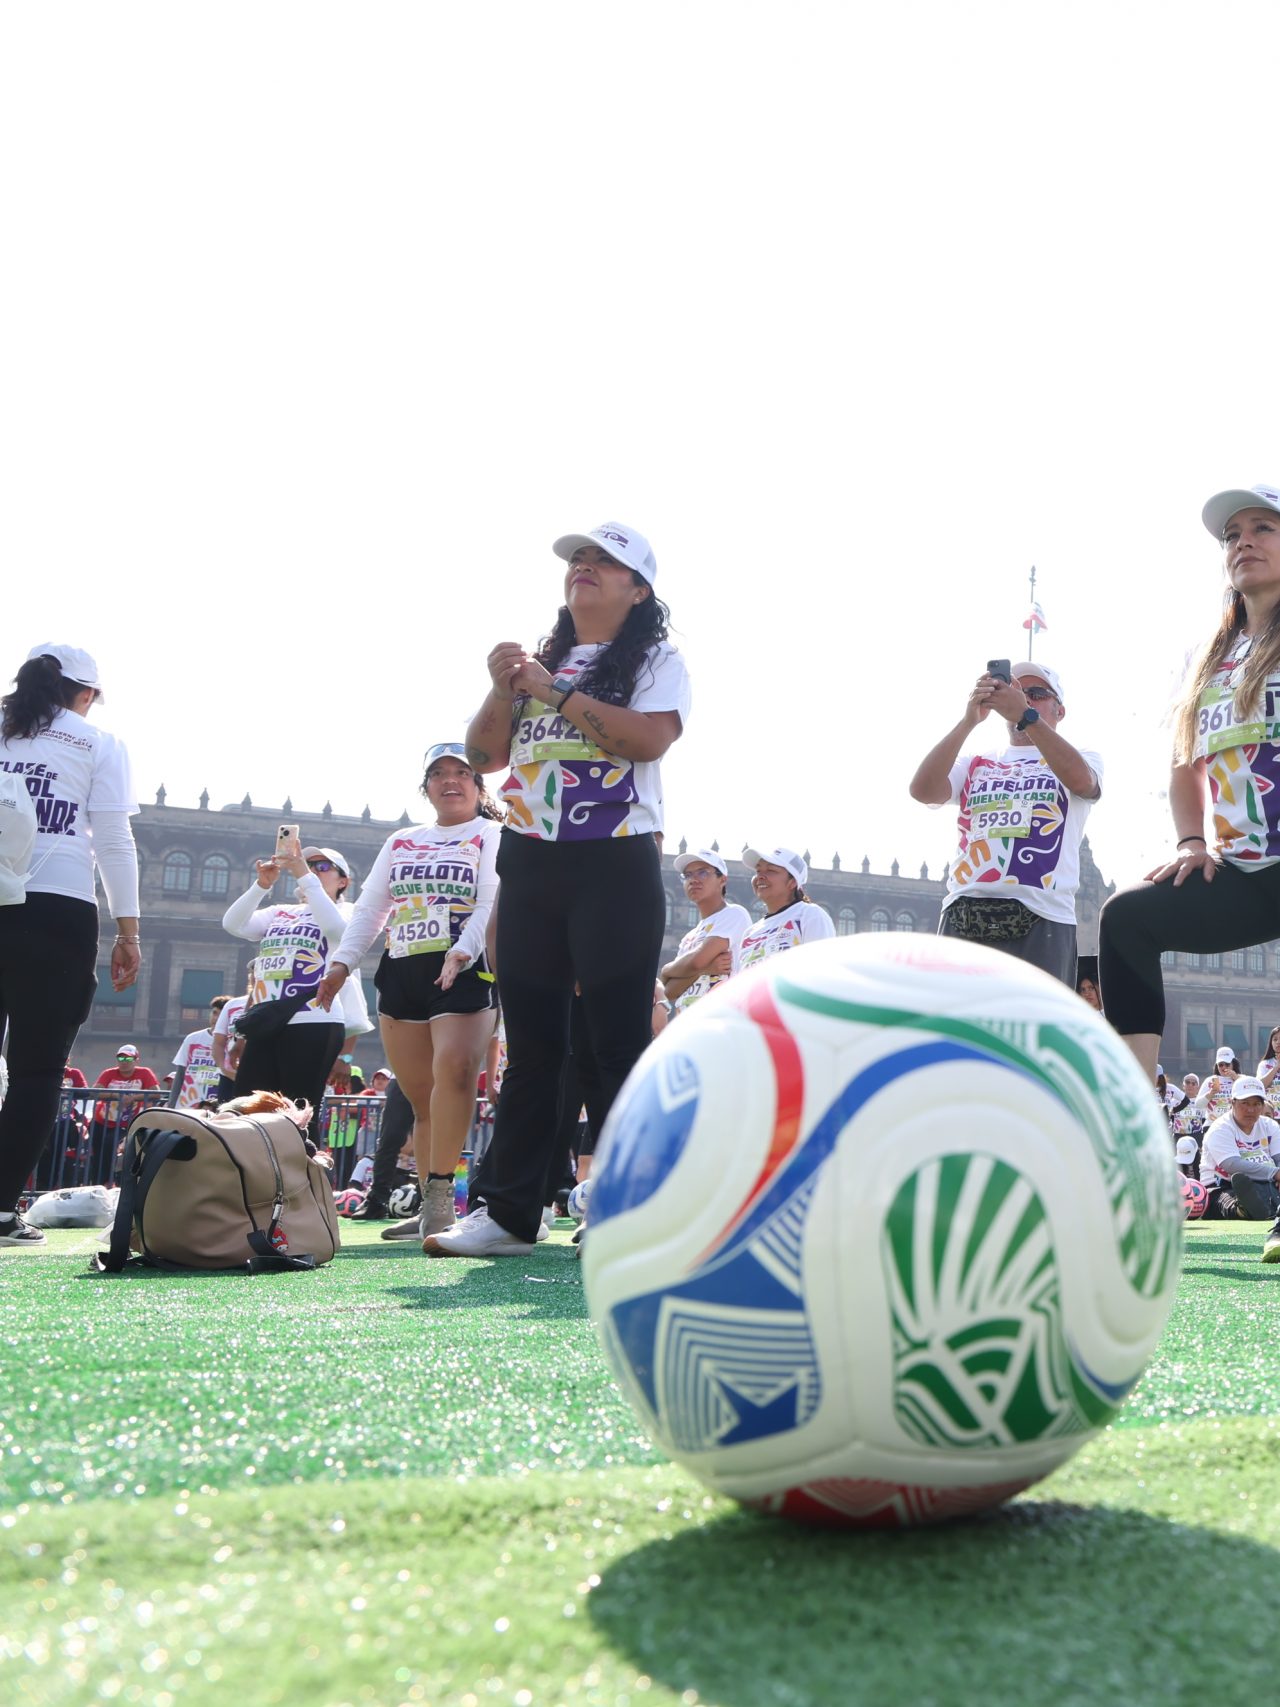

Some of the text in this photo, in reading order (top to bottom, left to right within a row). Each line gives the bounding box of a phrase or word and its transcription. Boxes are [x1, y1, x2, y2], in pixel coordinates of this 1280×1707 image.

[1200, 700, 1246, 736] 361
[46, 771, 58, 780] DE
[25, 777, 55, 799] OL
[971, 777, 1057, 795] LA PELOTA
[1024, 792, 1055, 803] CASA
[978, 811, 1022, 828] 5930
[401, 864, 475, 884] PELOTA
[393, 883, 472, 897] ELVE A CASA
[269, 925, 321, 941] PELOTA
[397, 919, 440, 942] 4520
[282, 937, 289, 946] A
[291, 937, 317, 950] CASA
[260, 956, 286, 970] 1849
[200, 1058, 216, 1067] PEL
